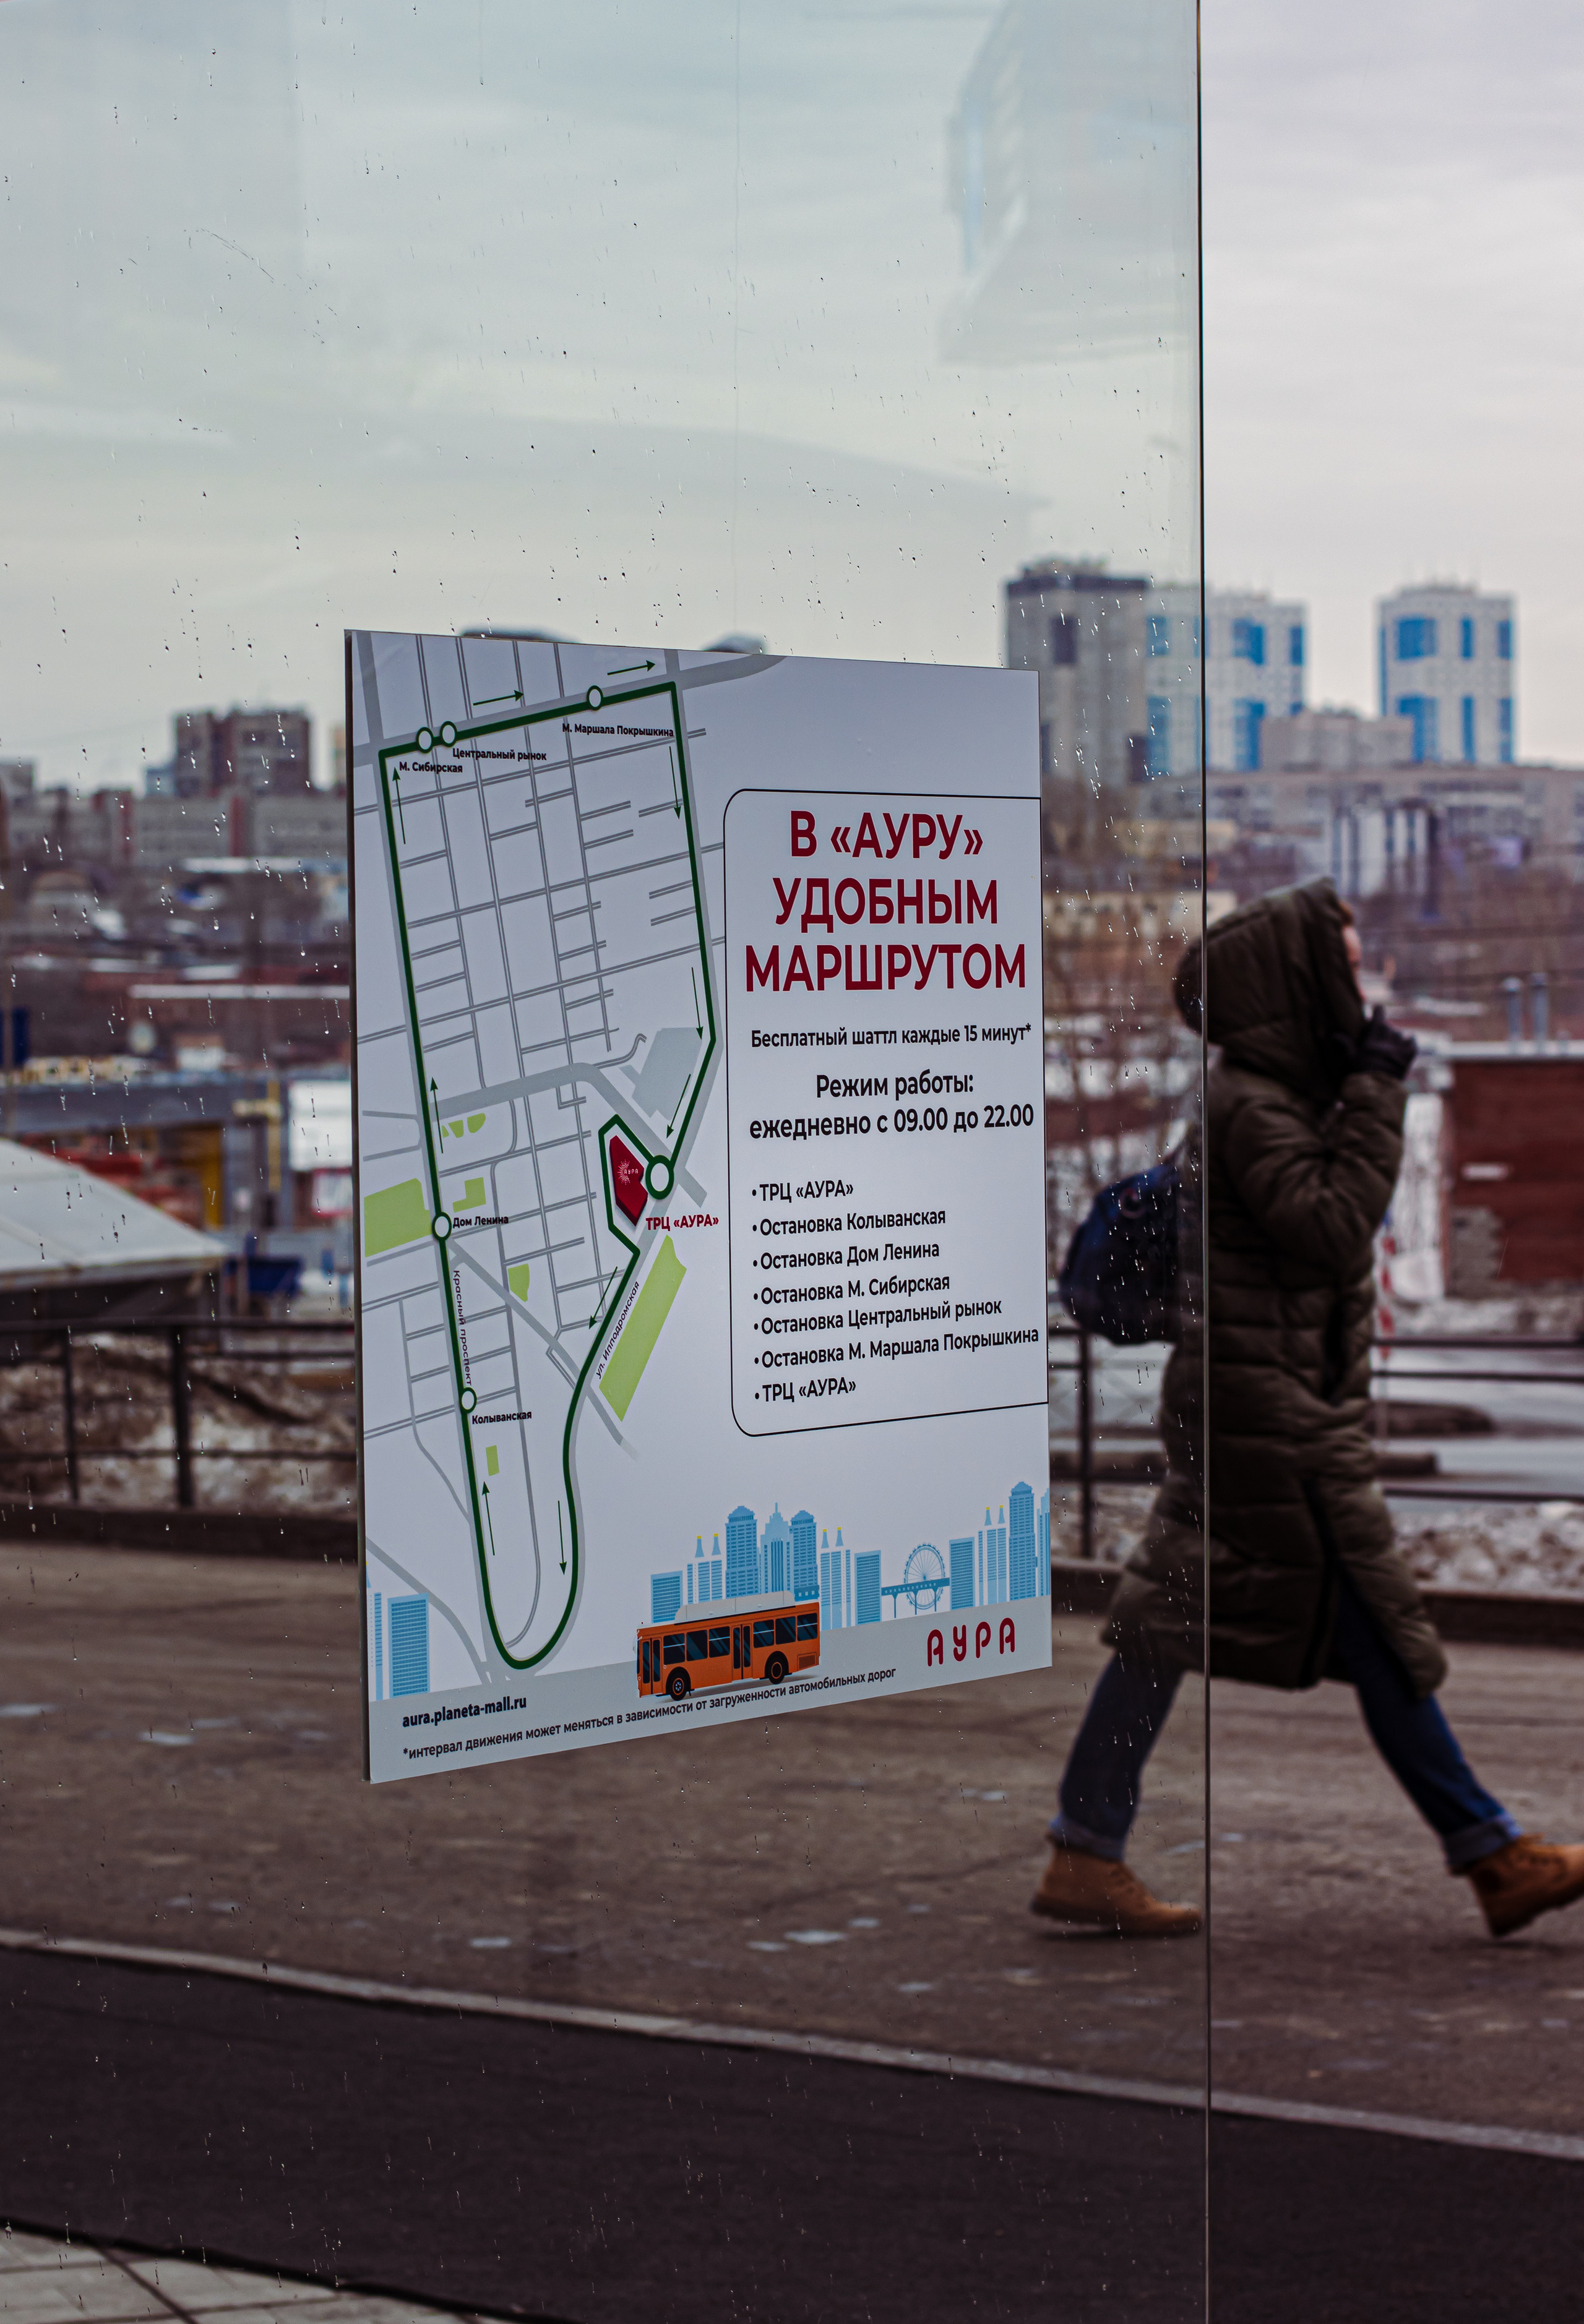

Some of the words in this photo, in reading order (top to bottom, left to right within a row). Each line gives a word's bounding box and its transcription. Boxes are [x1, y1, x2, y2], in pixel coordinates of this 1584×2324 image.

[562, 723, 572, 732] М.
[575, 724, 614, 735] Маршала
[618, 726, 673, 737] Покрышкина
[400, 761, 410, 771] М.
[413, 762, 462, 774] Сибирская
[453, 748, 515, 760] Центральный
[518, 752, 546, 761] рынок
[791, 811, 816, 856] В
[831, 813, 983, 859] «АУРУ»
[773, 878, 997, 933] УДОБНЫМ
[746, 944, 1025, 992] МАРШРУТОМ
[752, 1027, 846, 1047] Бесплатный
[853, 1031, 897, 1044] шаттл
[902, 1029, 960, 1045] каждые
[965, 1025, 977, 1041] 15
[817, 1075, 887, 1097] Режим
[895, 1069, 973, 1100] работы:
[750, 1116, 871, 1140] ежедневно
[877, 1115, 887, 1133] с
[894, 1107, 947, 1132] 09.00
[954, 1112, 978, 1133] до
[984, 1104, 1033, 1128] 22.00
[760, 1183, 791, 1203] ТРЦ
[796, 1180, 853, 1198] «АУРА»
[453, 1218, 471, 1228] Дом
[475, 1217, 509, 1225] Ленина
[646, 1217, 670, 1231] ТРЦ
[674, 1214, 718, 1228] «АУРА»
[760, 1218, 842, 1235] Остановка
[848, 1211, 945, 1230] Колыванская
[761, 1251, 842, 1269] Остановка
[847, 1246, 878, 1266] Дом
[884, 1244, 939, 1260] Ленина
[761, 1285, 843, 1304] Остановка
[848, 1280, 864, 1297] М.
[869, 1276, 949, 1297] Сибирская
[454, 1271, 466, 1324] Красный
[461, 1329, 471, 1386] проспект
[596, 1364, 605, 1379] ул.
[603, 1282, 639, 1361] Ипподромская
[762, 1315, 843, 1334] Остановка
[849, 1301, 950, 1329] Центральный
[956, 1301, 1002, 1321] рынок
[762, 1348, 843, 1368] Остановка
[850, 1342, 865, 1360] М.
[871, 1339, 939, 1360] Маршала
[944, 1329, 1038, 1352] Покрышкина
[762, 1383, 794, 1402] ТРЦ
[799, 1377, 856, 1397] «АУРА»
[472, 1411, 532, 1425] Колыванская
[928, 1618, 1015, 1666] АУРА
[403, 1696, 526, 1727] aura.planeta-mall.ru
[466, 1731, 522, 1751] движения
[526, 1725, 561, 1739] может
[564, 1717, 613, 1733] меняться
[618, 1715, 622, 1723] в
[626, 1703, 692, 1722] зависимости
[696, 1700, 707, 1710] от
[710, 1686, 786, 1709] загруженности
[789, 1674, 866, 1694] автомобильных
[868, 1669, 895, 1683] дорог
